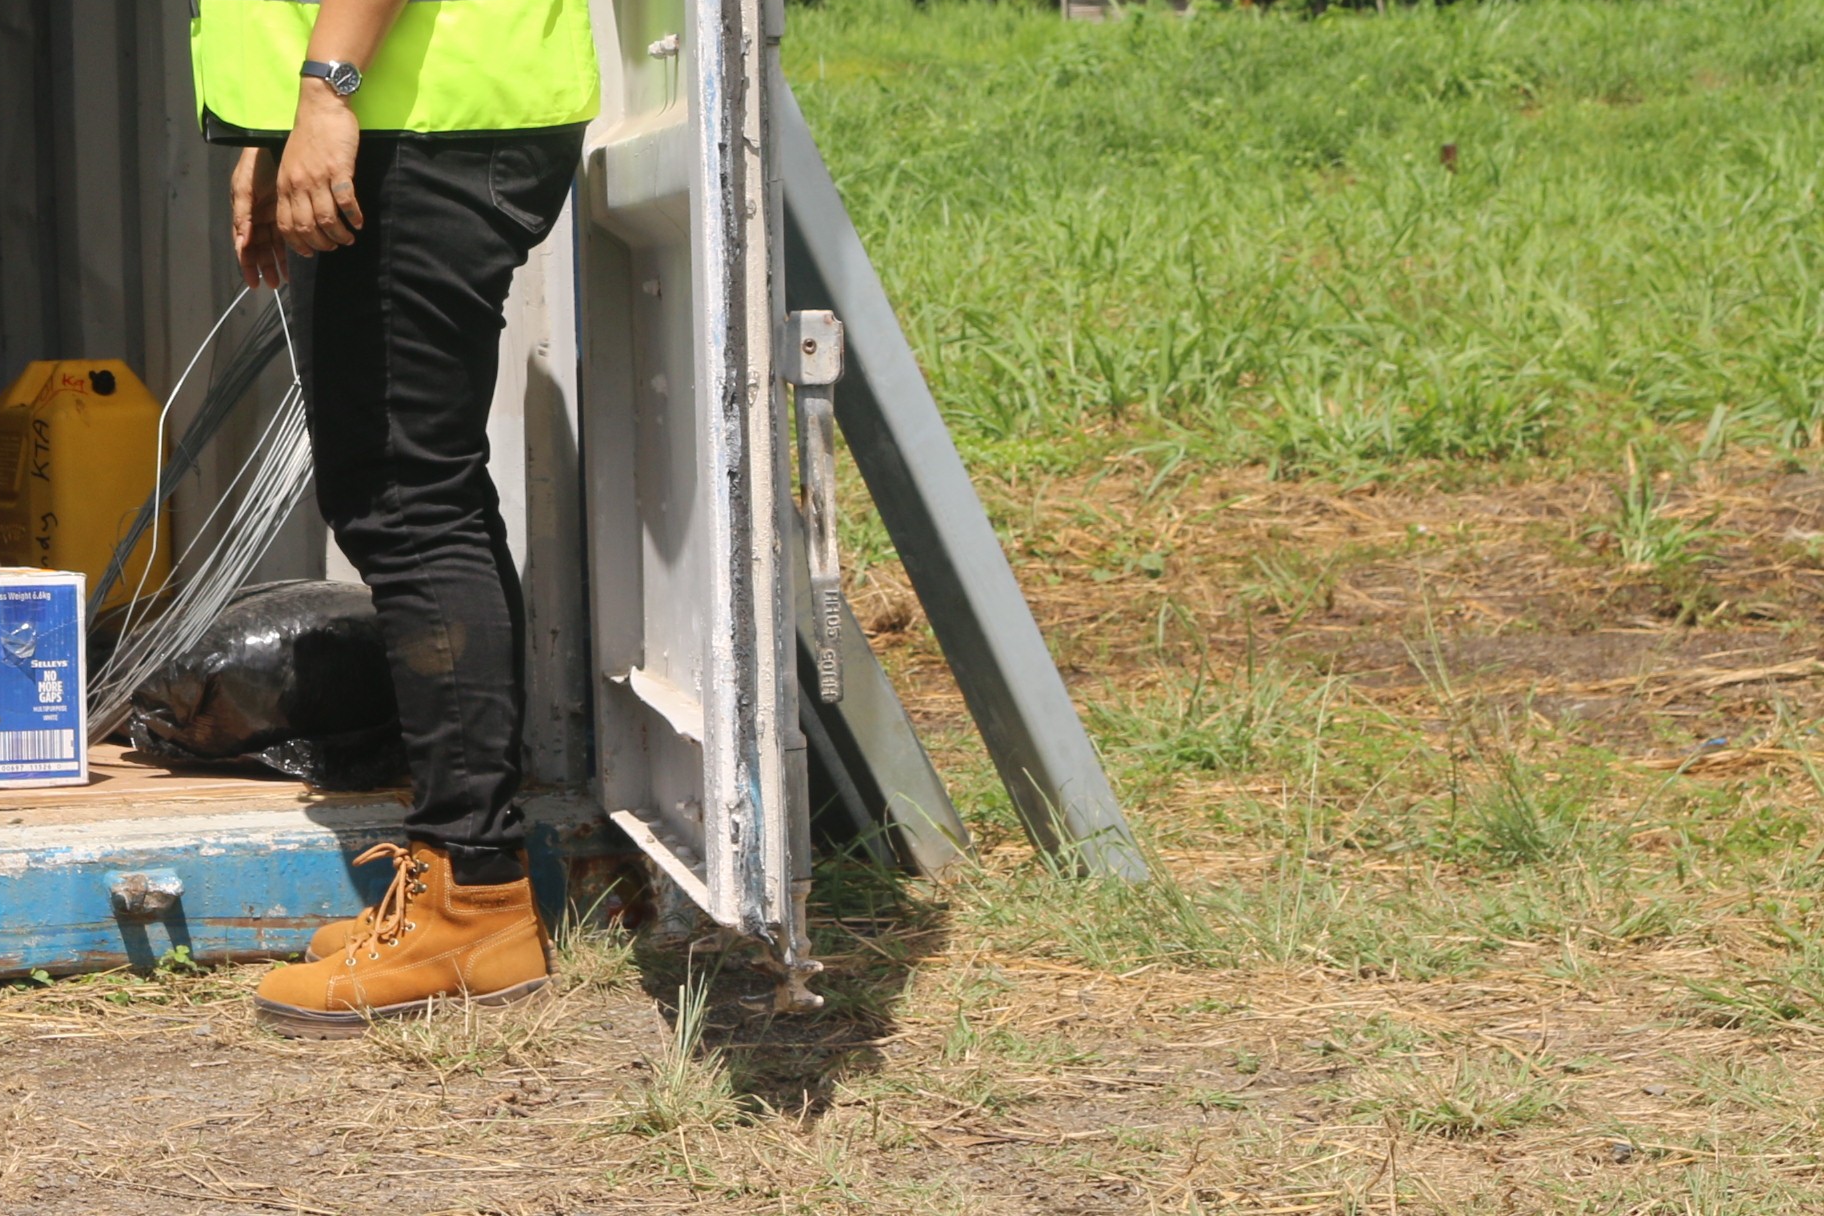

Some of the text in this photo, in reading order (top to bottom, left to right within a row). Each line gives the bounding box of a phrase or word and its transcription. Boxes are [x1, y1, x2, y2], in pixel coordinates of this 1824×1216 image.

[30, 419, 58, 568] ndy KTA
[8, 591, 32, 601] Weight
[31, 660, 68, 668] SELLEYS
[44, 670, 57, 681] NO
[38, 681, 63, 692] MORE
[39, 692, 63, 703] GAPS
